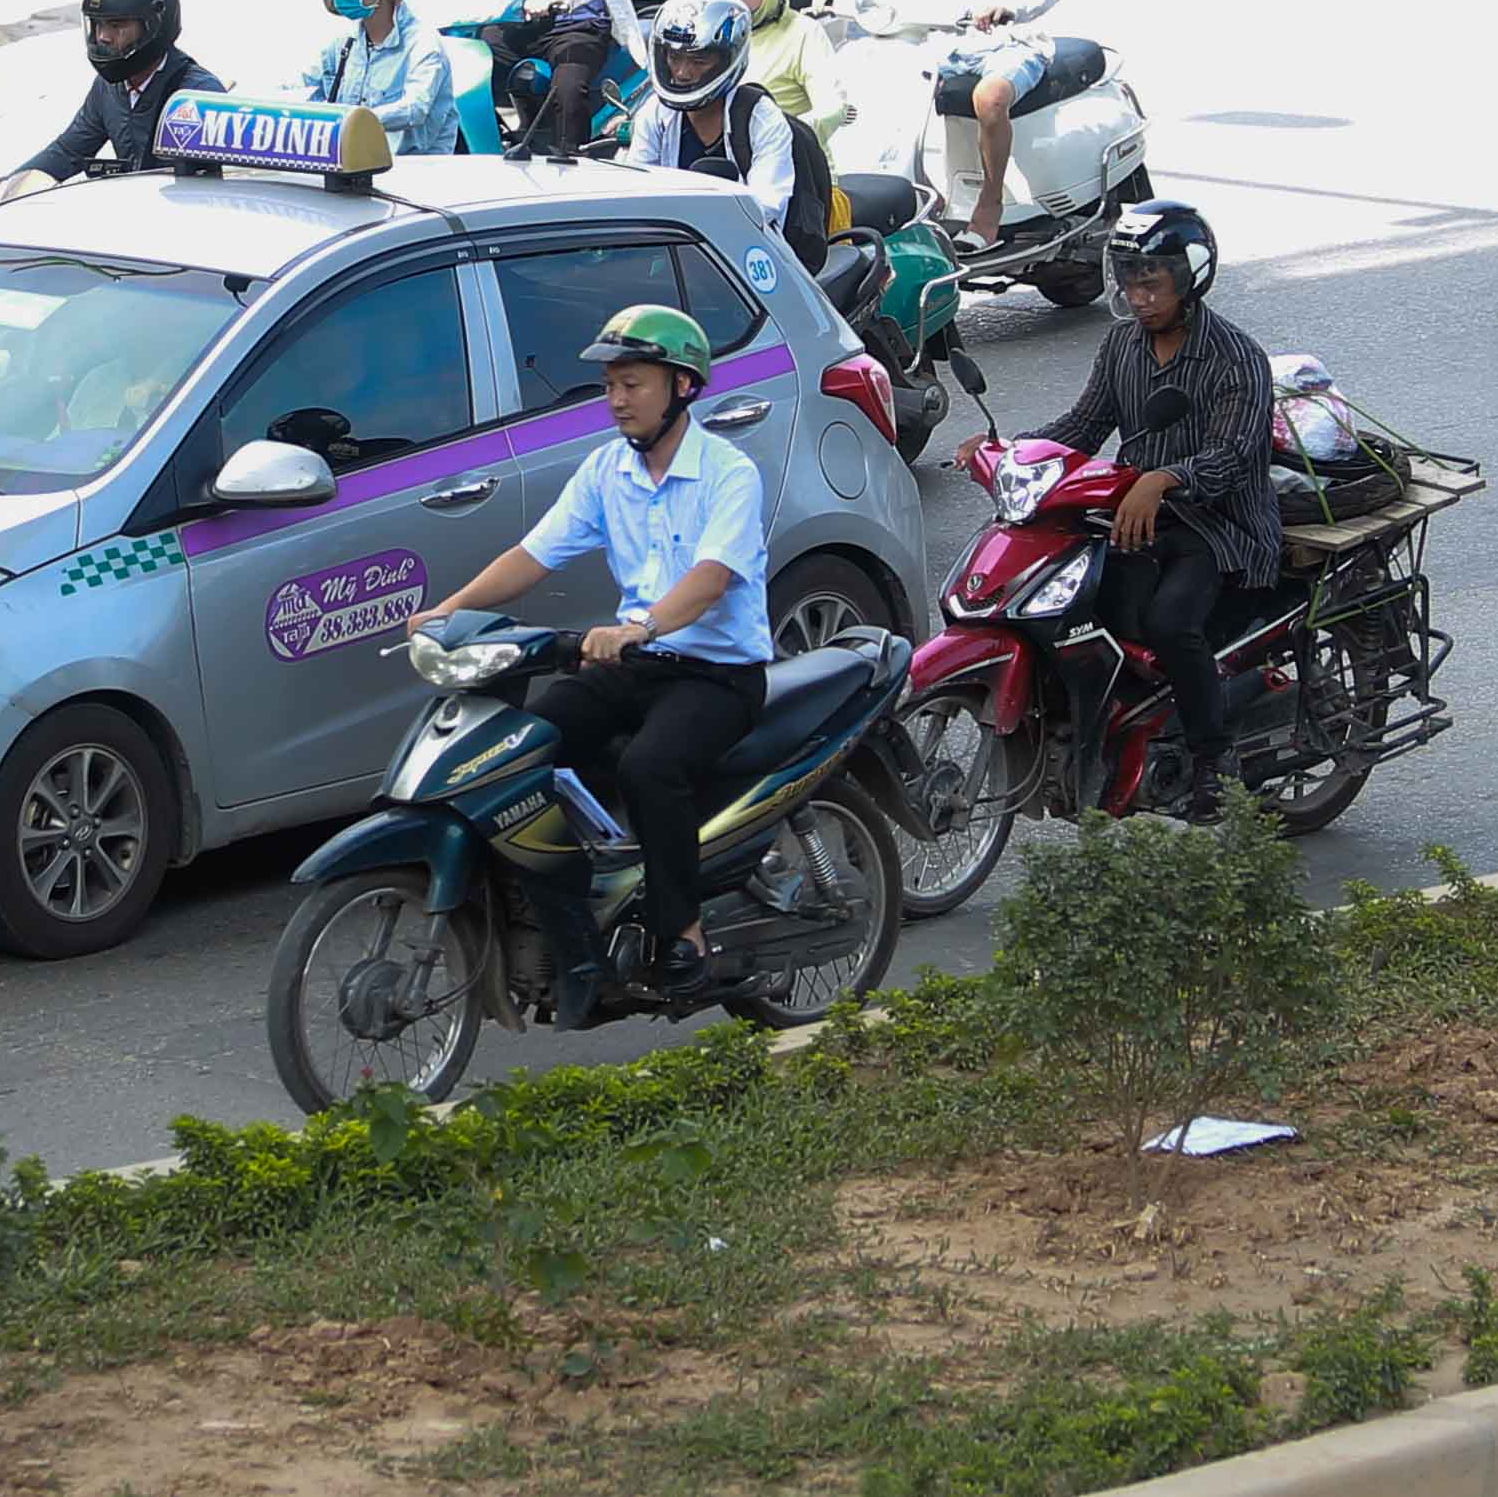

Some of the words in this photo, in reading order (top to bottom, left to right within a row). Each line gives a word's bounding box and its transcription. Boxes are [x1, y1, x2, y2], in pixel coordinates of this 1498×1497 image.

[200, 107, 252, 150] MỸ
[251, 109, 336, 158] ĐÌNH
[749, 260, 774, 282] 381
[320, 576, 358, 603] Mỹ
[363, 559, 410, 591] Đình
[320, 594, 415, 643] 38.333.888
[1068, 622, 1095, 639] SYM
[492, 791, 548, 830] YAMAHA
